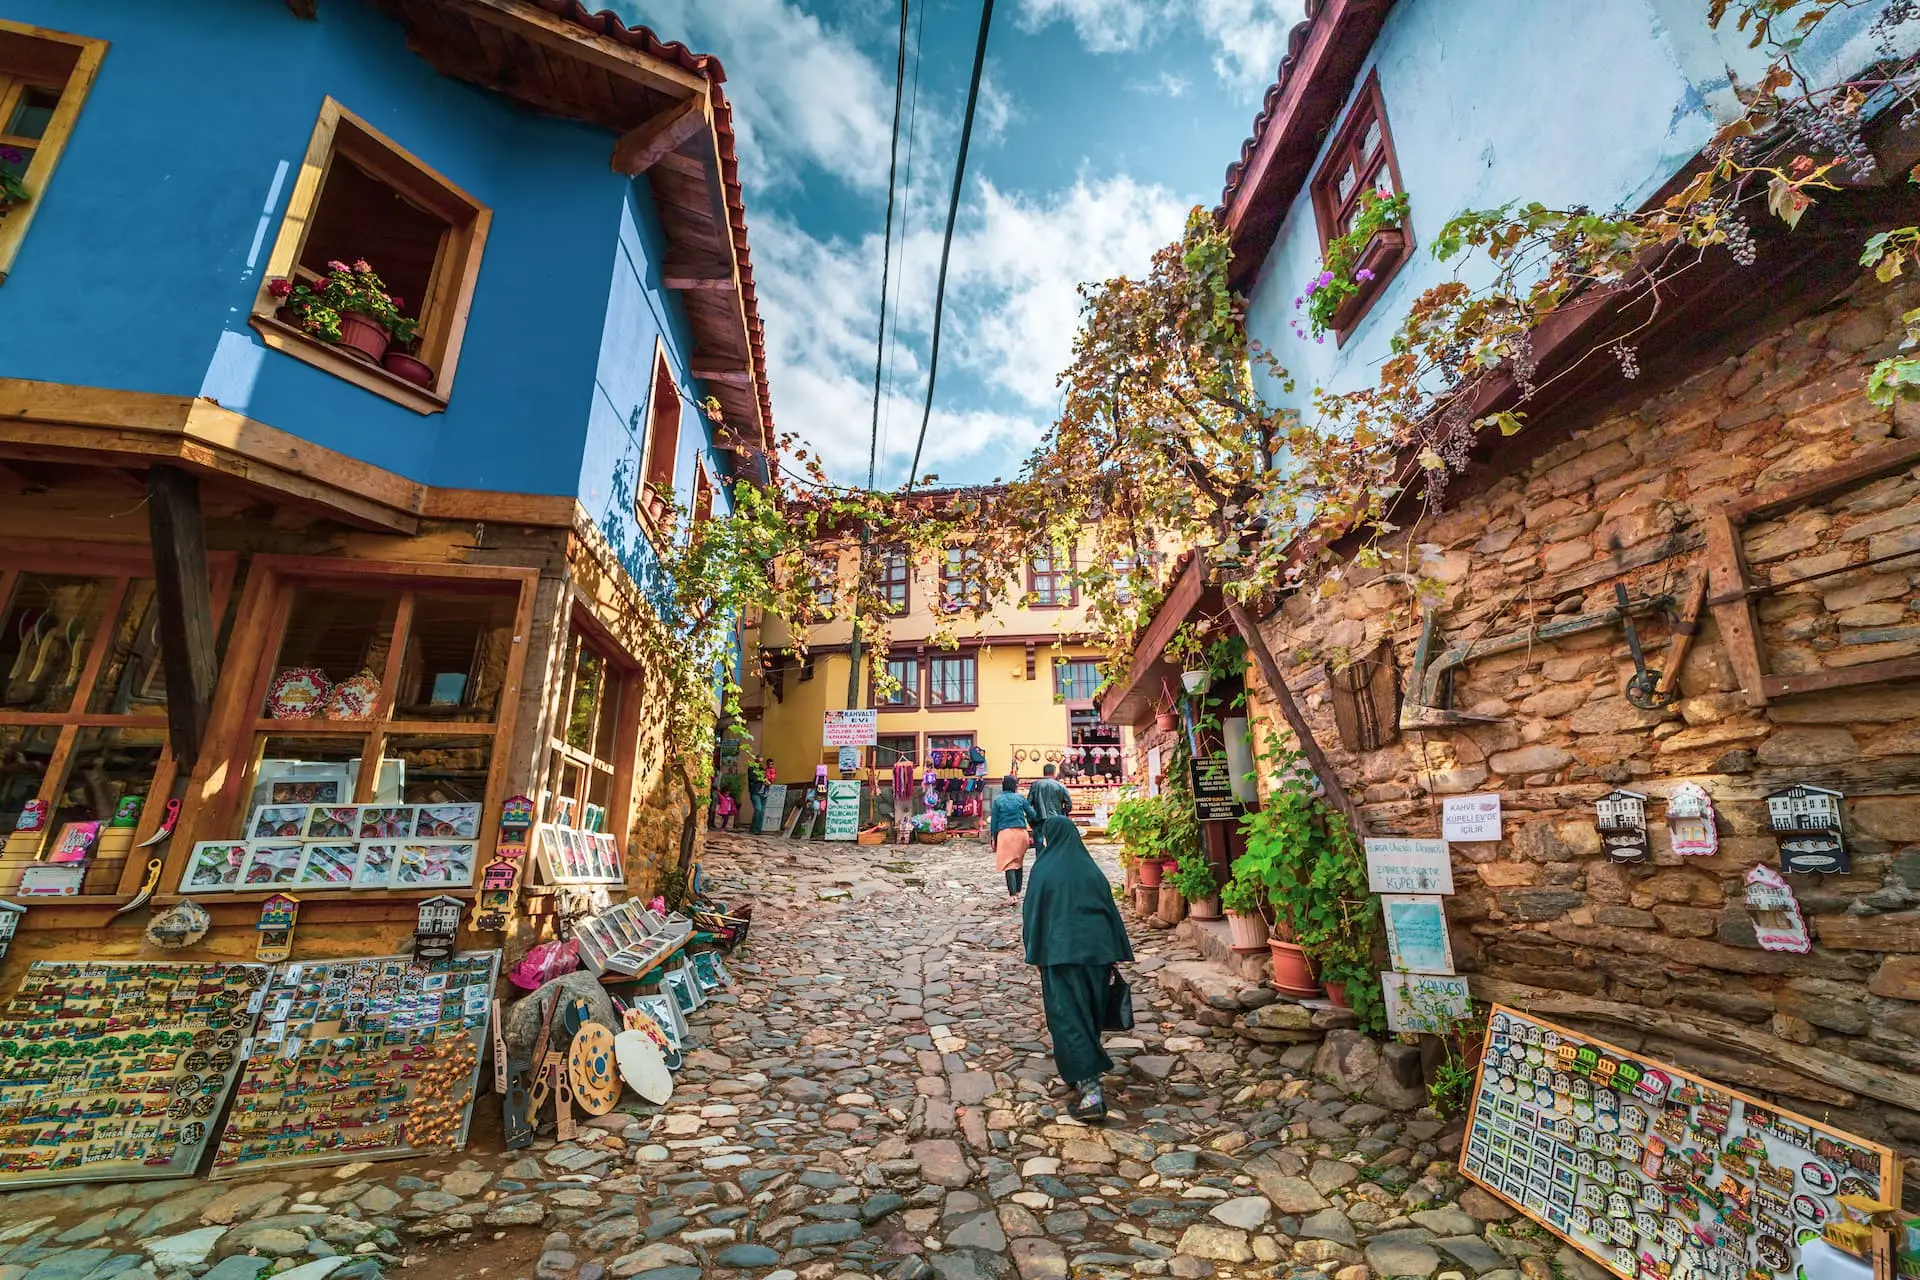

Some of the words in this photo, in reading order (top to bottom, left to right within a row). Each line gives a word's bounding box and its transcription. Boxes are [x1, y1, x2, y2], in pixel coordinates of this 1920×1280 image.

[1450, 803, 1476, 811] KAHVE
[94, 1130, 123, 1140] BURSA
[1688, 1132, 1721, 1150] BURSA
[1769, 1128, 1812, 1151] BURSA
[81, 1153, 114, 1163] BURSA
[1751, 1196, 1794, 1219] BURSA
[1752, 1218, 1793, 1247] BURSA
